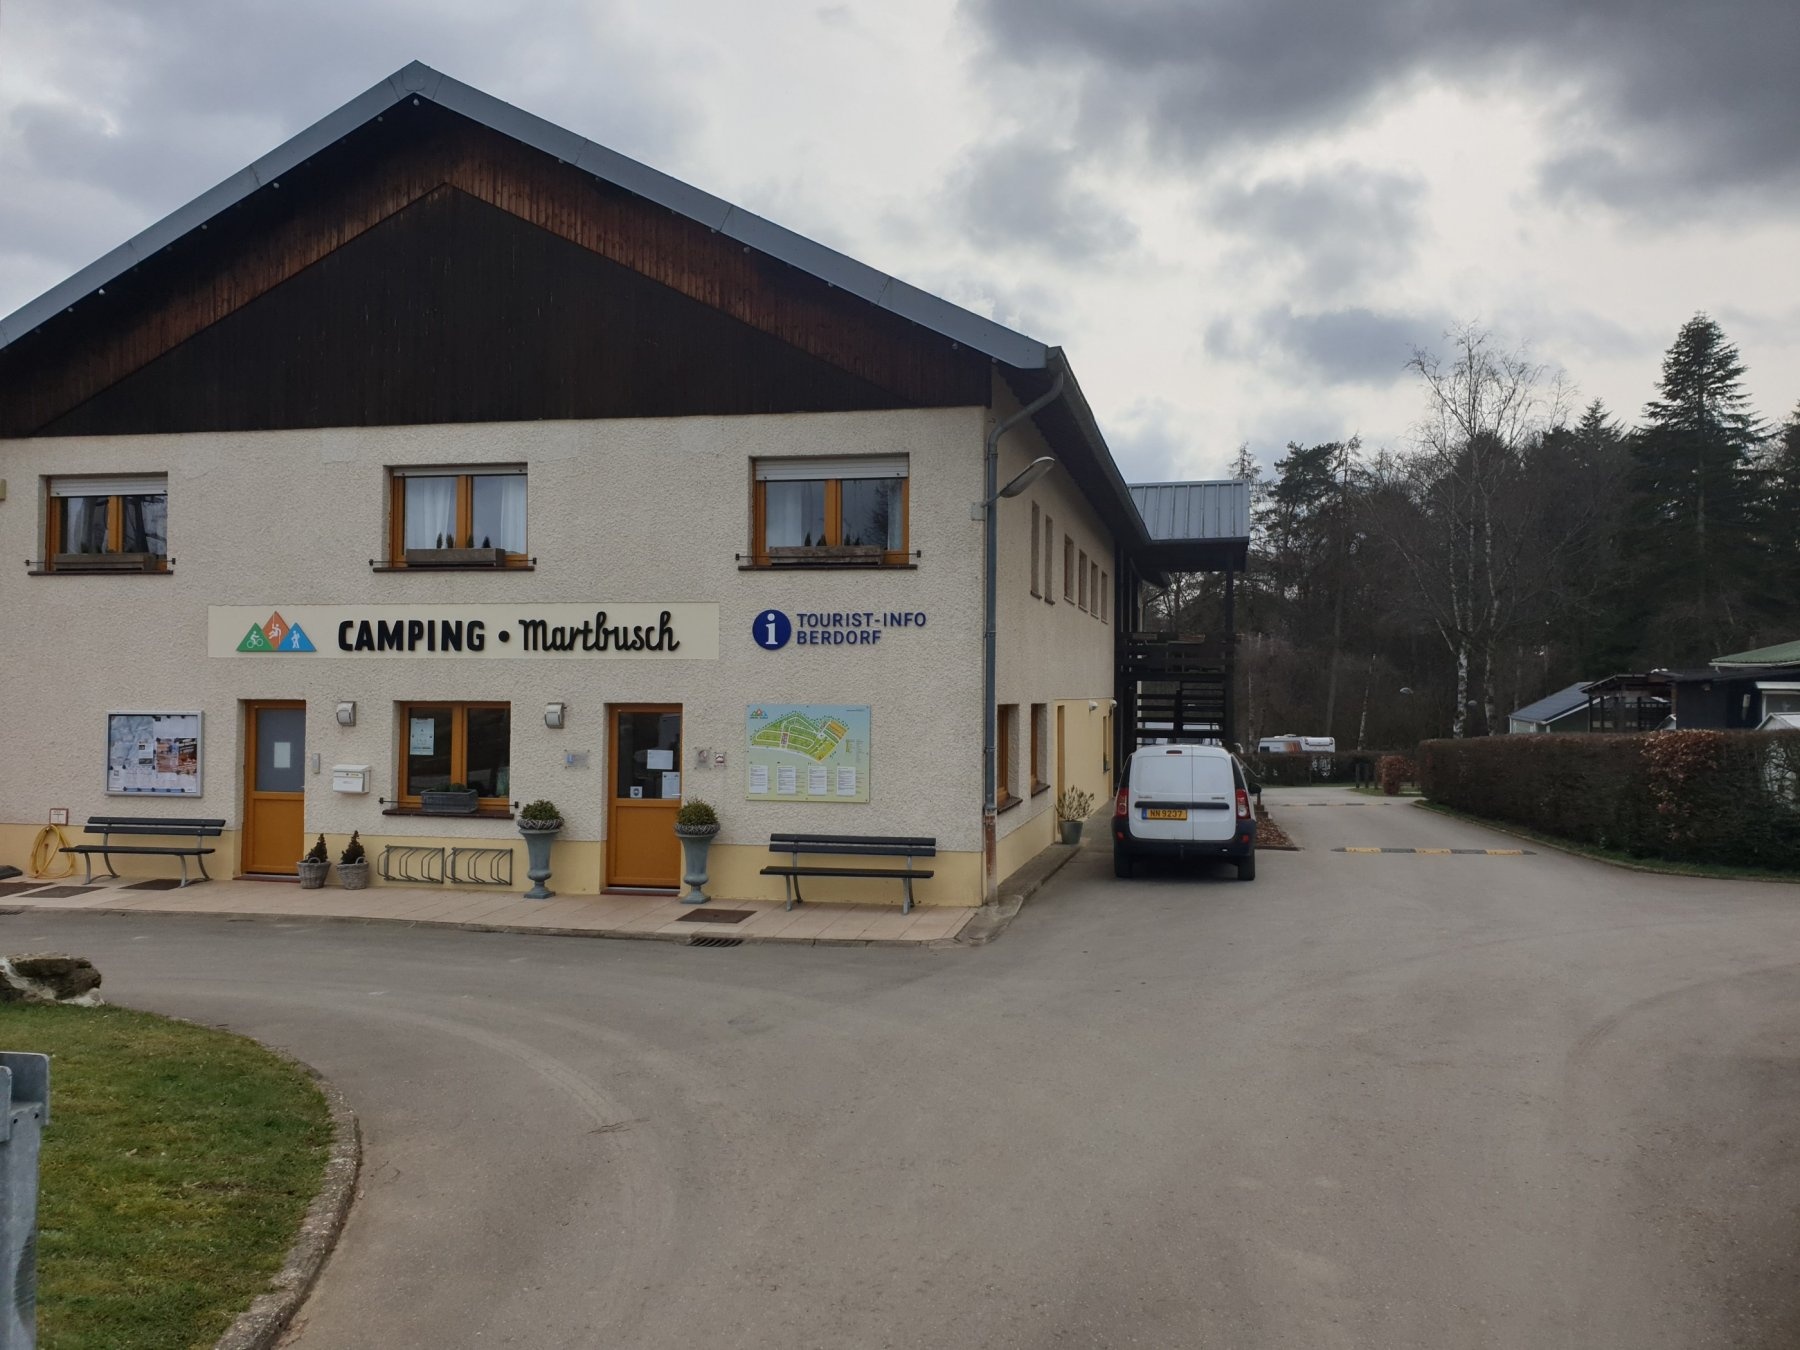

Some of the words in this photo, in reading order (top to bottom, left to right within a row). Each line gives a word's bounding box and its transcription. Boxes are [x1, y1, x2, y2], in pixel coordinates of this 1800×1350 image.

[796, 612, 927, 628] TOURIST-INFO
[338, 620, 485, 651] CAMPING
[518, 610, 680, 652] Martbusch
[796, 630, 882, 645] BERDORF
